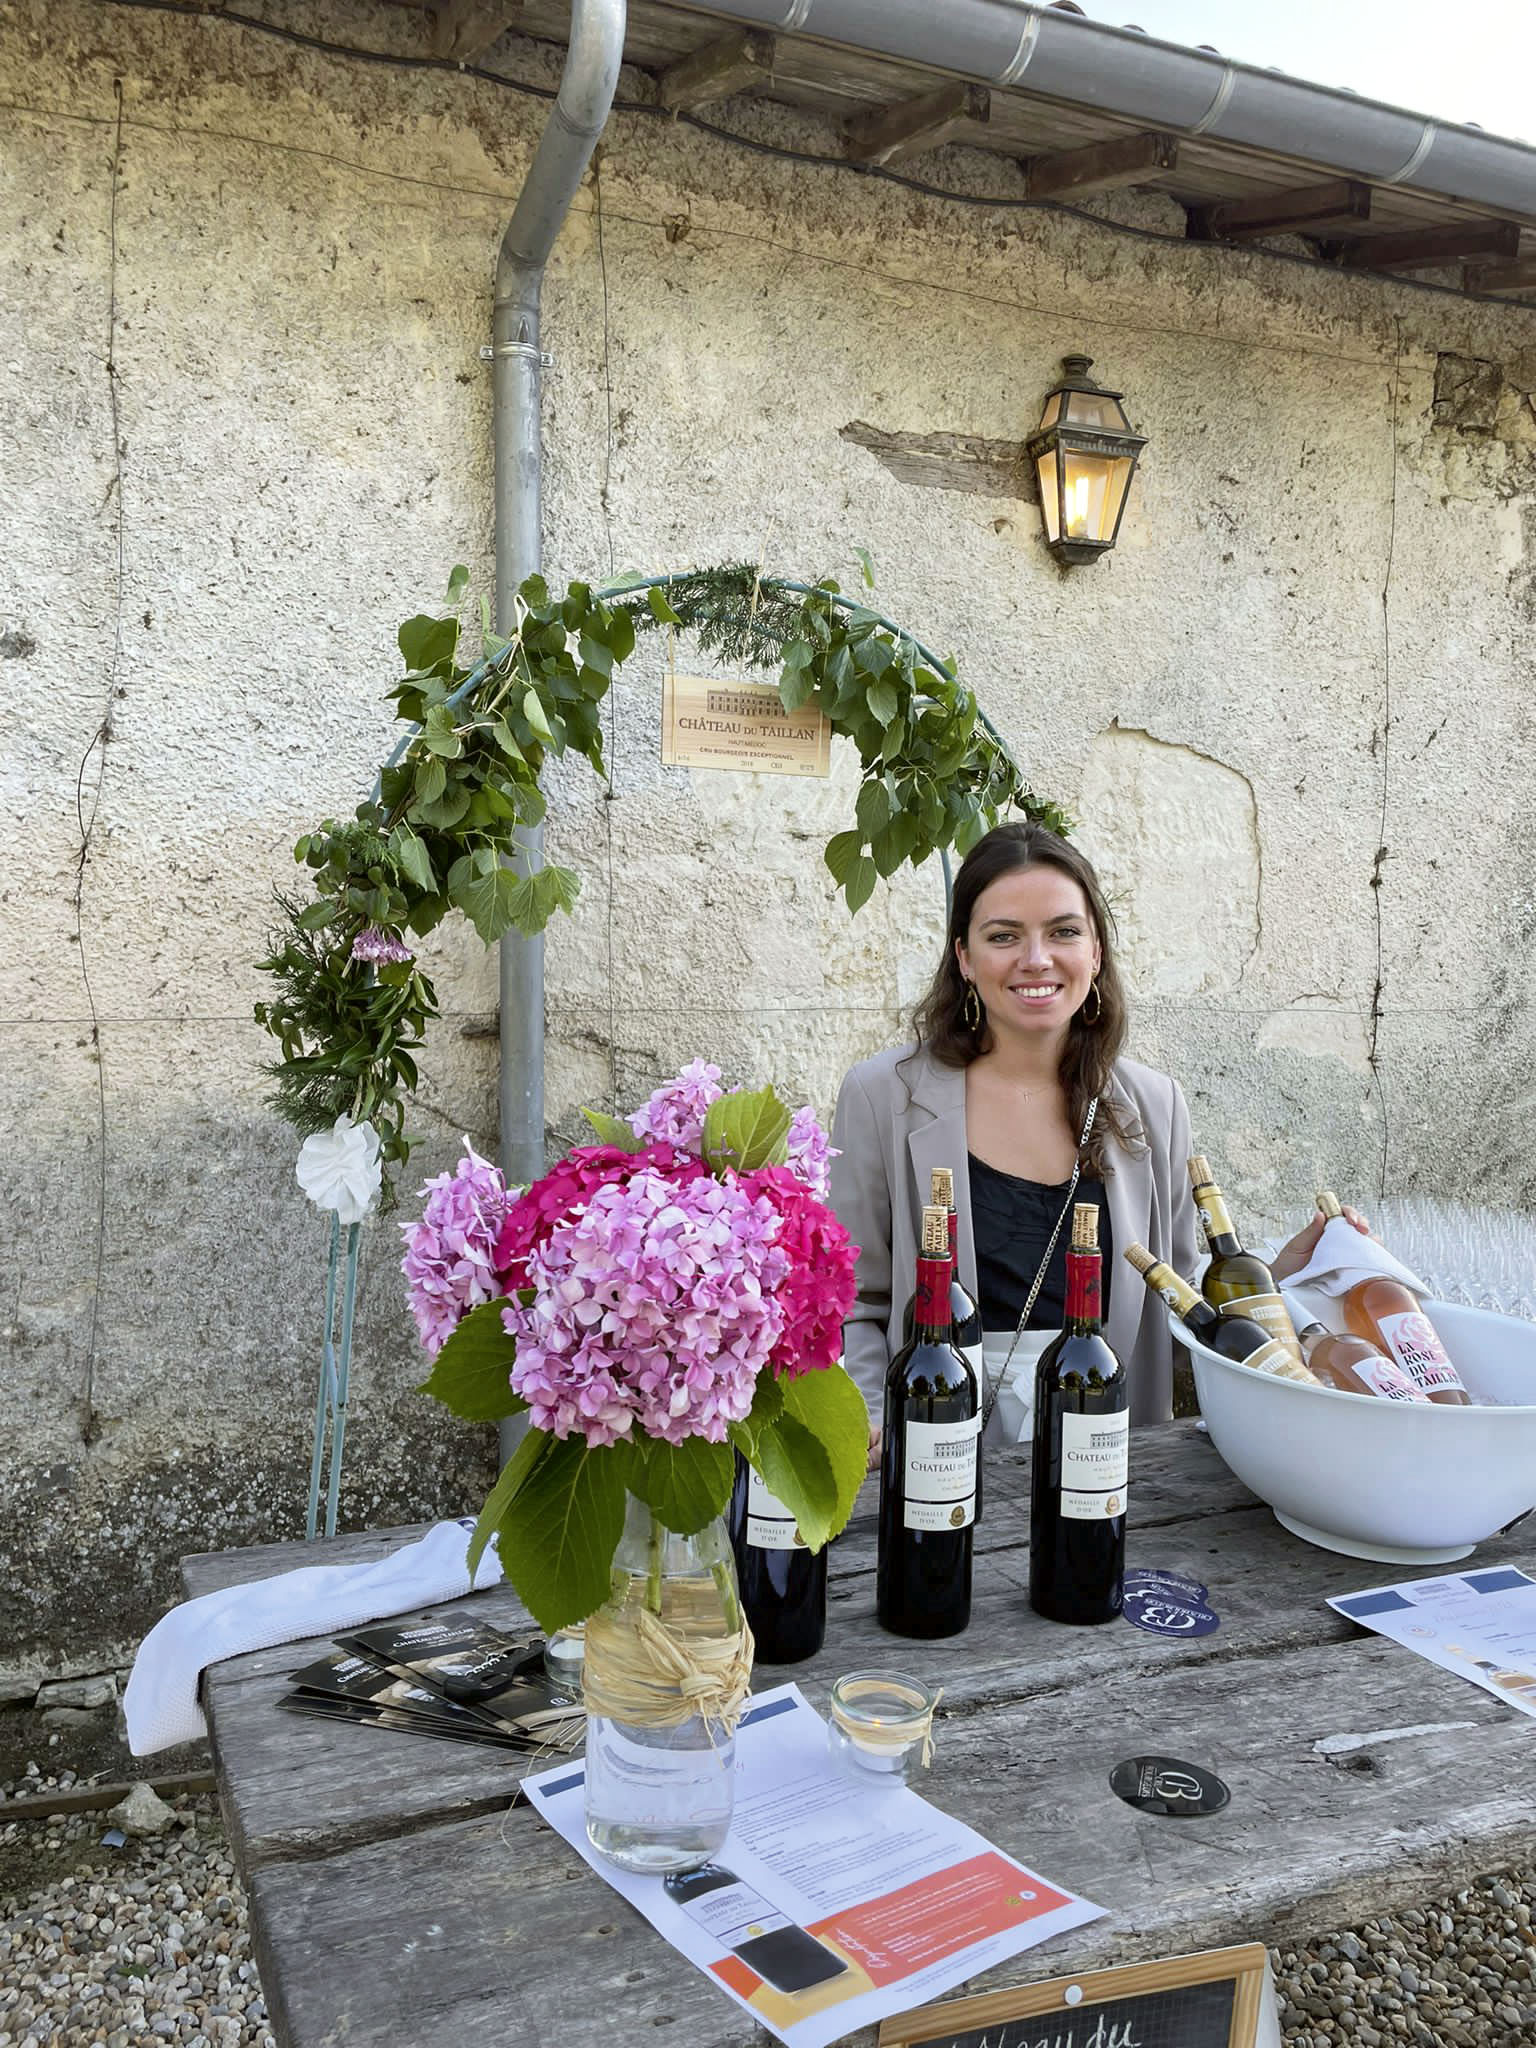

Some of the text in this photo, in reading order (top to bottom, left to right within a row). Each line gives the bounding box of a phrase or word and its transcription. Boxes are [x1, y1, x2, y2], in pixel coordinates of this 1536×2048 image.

[679, 717, 815, 740] CHÂTEAU DU TAILLAN
[1398, 1342, 1415, 1354] LA
[1408, 1363, 1427, 1377] DU
